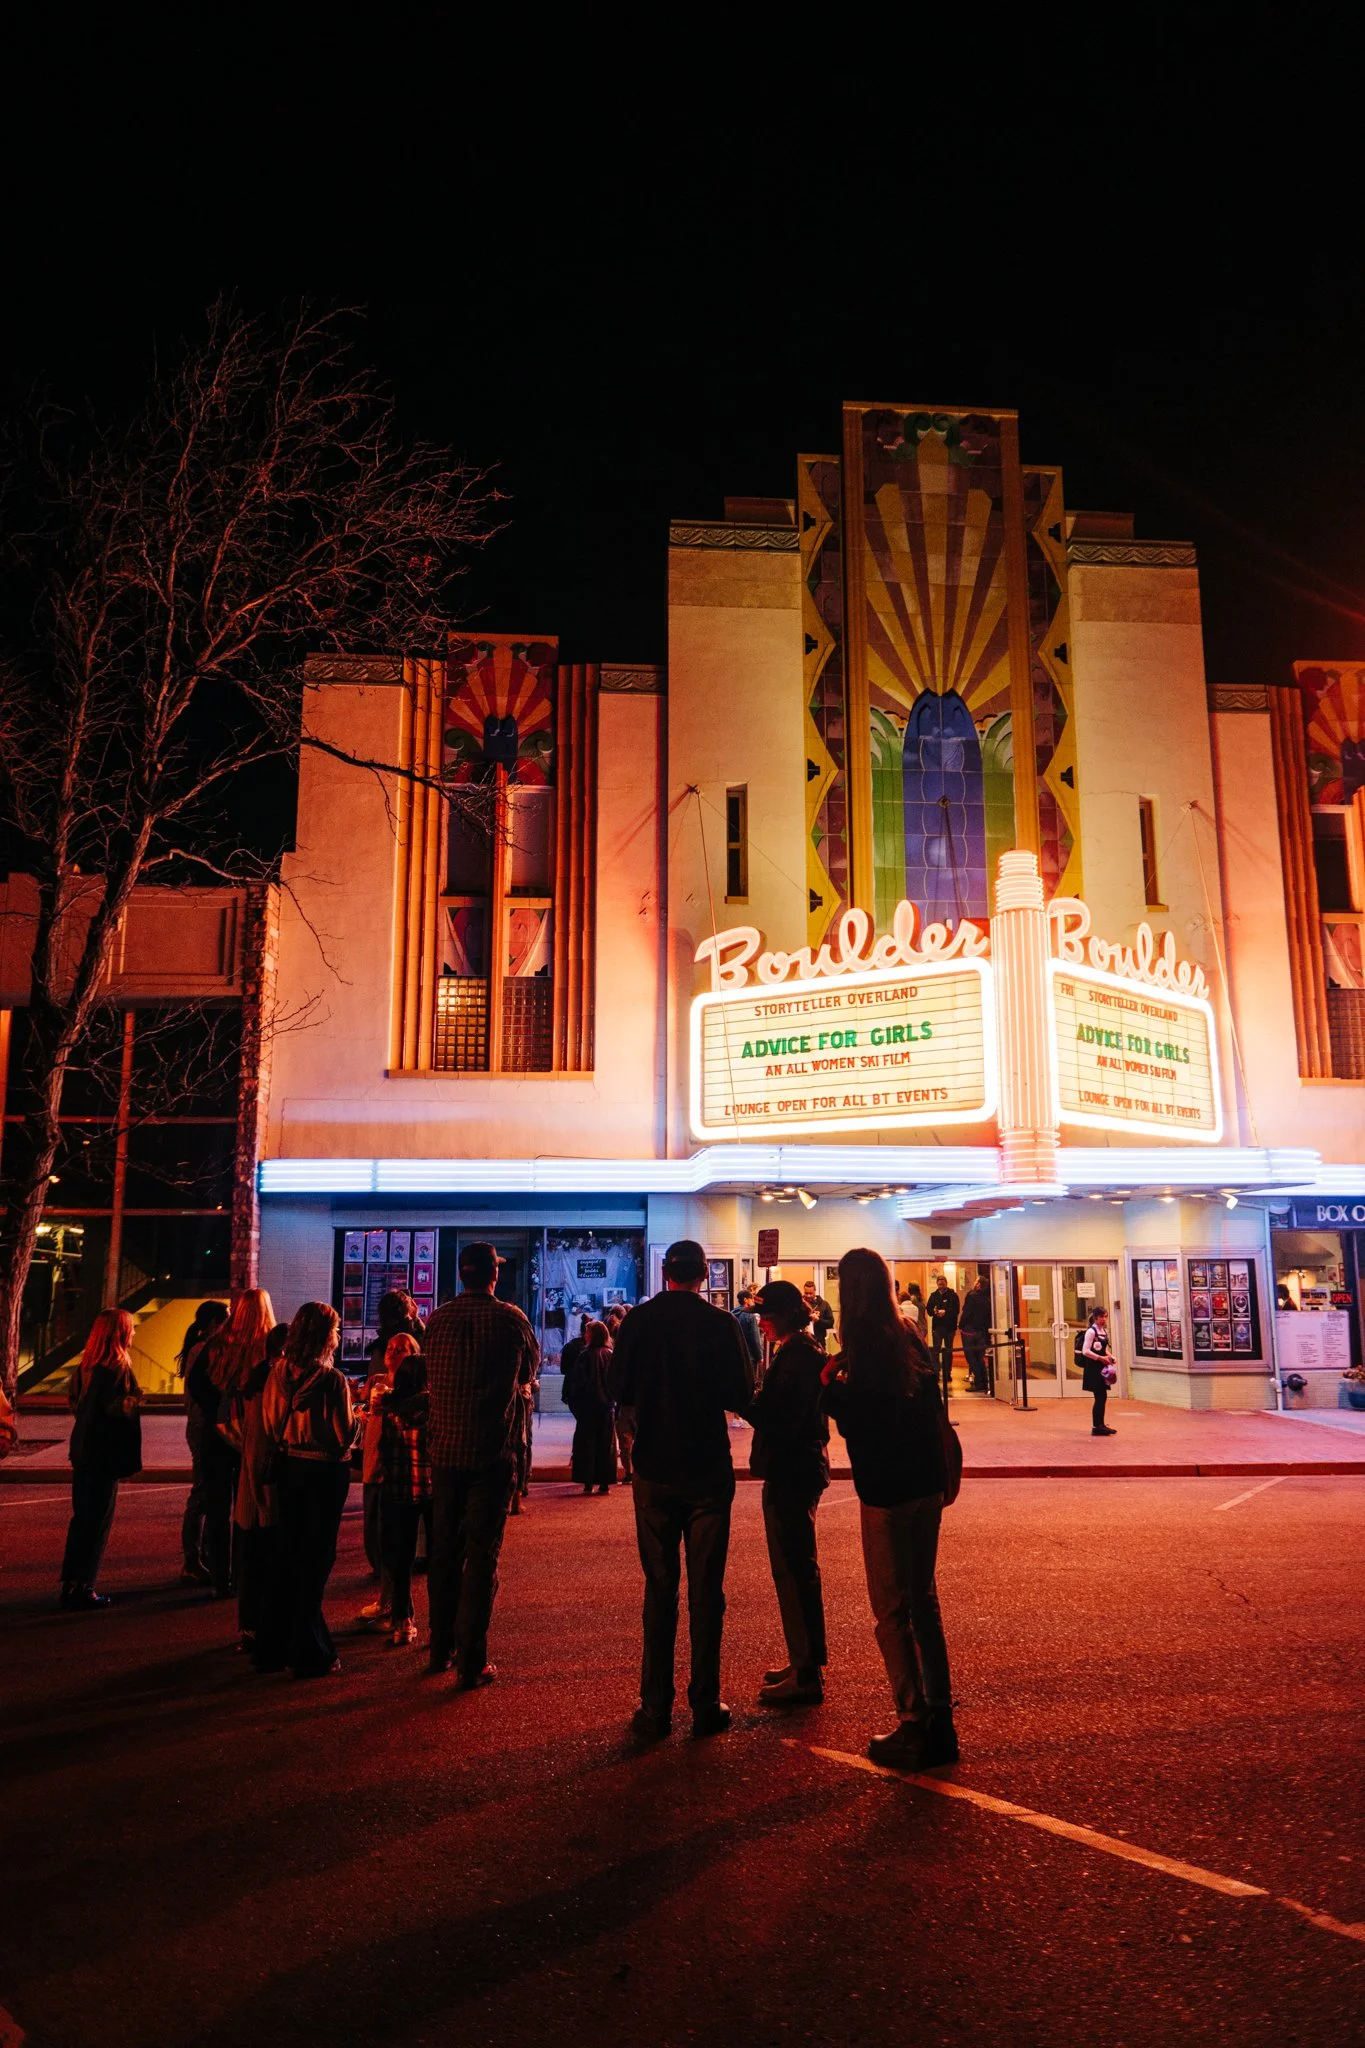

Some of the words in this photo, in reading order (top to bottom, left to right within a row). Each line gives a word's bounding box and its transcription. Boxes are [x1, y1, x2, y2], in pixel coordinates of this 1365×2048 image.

[694, 899, 990, 992] Boulder
[1047, 897, 1209, 1000] Boulder
[755, 996, 841, 1016] STORYTELLER
[847, 986, 918, 1005] OVERLAND
[1089, 990, 1138, 1012] STORYTELLER
[1141, 1003, 1178, 1022] OVERLAND
[741, 1035, 811, 1058] ADVICE
[818, 1029, 857, 1050] FOR
[871, 1021, 933, 1046] GIRLS
[1076, 1023, 1122, 1050] ADVICE
[1128, 1034, 1151, 1056] FOR
[1155, 1041, 1190, 1064] GIRLS
[765, 1065, 782, 1076] AN
[787, 1063, 808, 1074] ALL
[812, 1057, 855, 1071] WOMEN
[861, 1055, 879, 1067] SKI
[884, 1052, 911, 1066] FILM
[1109, 1058, 1122, 1070] ALL
[1123, 1060, 1148, 1075] WOMEN
[724, 1102, 770, 1116] LOUNGE
[777, 1099, 807, 1112] OPEN
[813, 1097, 836, 1109] FOR
[843, 1094, 867, 1107] ALL
[873, 1093, 890, 1104] BT
[897, 1087, 948, 1104] EVENTS
[1079, 1090, 1109, 1106] LOUNGE
[1114, 1095, 1132, 1109] OPEN
[1135, 1099, 1150, 1112] FOR
[1151, 1102, 1163, 1114] ALL
[1316, 1205, 1349, 1222] BOX
[1332, 1293, 1353, 1304] OPEN
